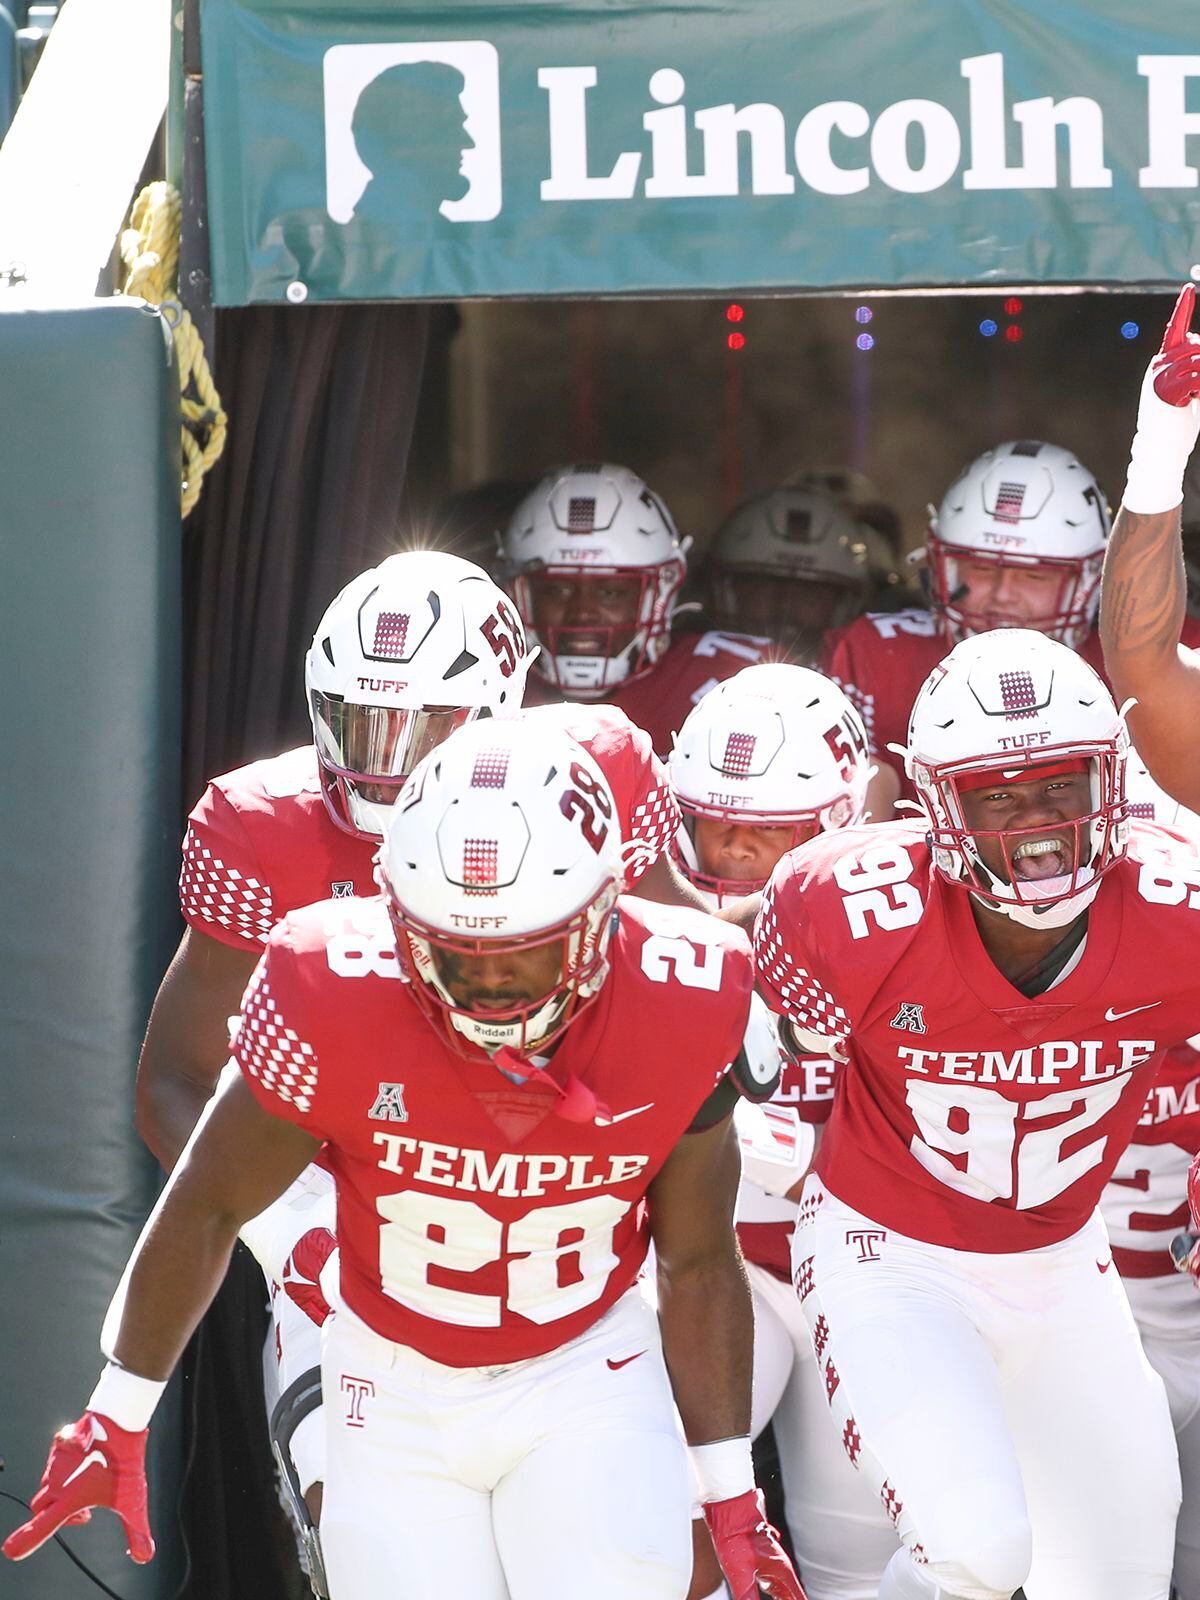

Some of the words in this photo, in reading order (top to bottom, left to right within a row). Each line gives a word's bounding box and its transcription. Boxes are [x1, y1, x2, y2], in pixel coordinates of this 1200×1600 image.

[537, 52, 1112, 201] Lincoln
[560, 548, 602, 560] TUFF
[983, 532, 1027, 547] TUFF
[357, 676, 408, 693] TUFF
[997, 730, 1052, 750] TUFF
[558, 761, 612, 855] 28
[707, 791, 753, 808] TUFF
[833, 845, 925, 940] 92
[450, 914, 508, 929] TUFF
[473, 1024, 514, 1038] Riddell
[897, 1040, 1156, 1085] TEMPLE
[905, 1071, 1134, 1211] 92
[372, 1131, 650, 1198] TEMPLE
[375, 1189, 633, 1328] 28
[846, 1230, 887, 1264] T
[340, 1374, 376, 1428] T
